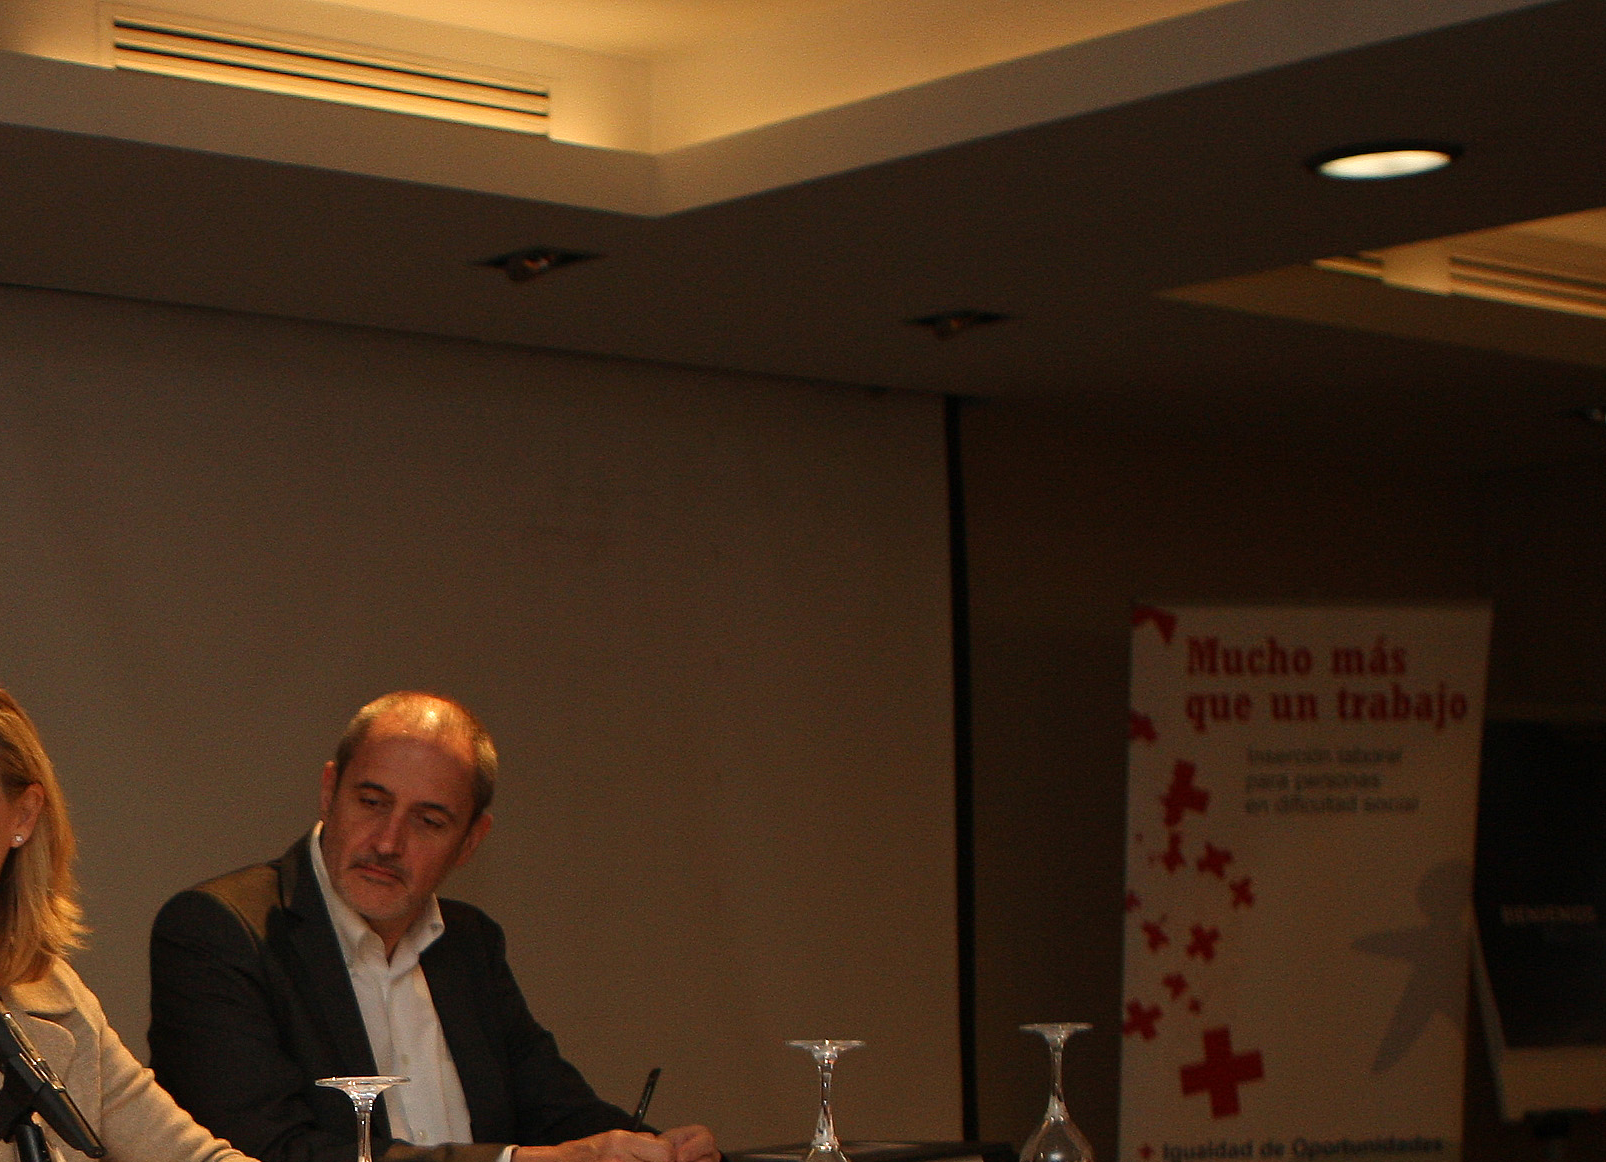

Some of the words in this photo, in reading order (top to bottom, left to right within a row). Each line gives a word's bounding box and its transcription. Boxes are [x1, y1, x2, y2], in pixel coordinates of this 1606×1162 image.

[1187, 635, 1313, 676] Mucho
[1332, 635, 1406, 676] más
[1185, 692, 1252, 733] que
[1270, 692, 1318, 722] un
[1336, 682, 1468, 733] trabajo
[1259, 1139, 1284, 1158] de
[1292, 1135, 1444, 1161] Oportunidades
